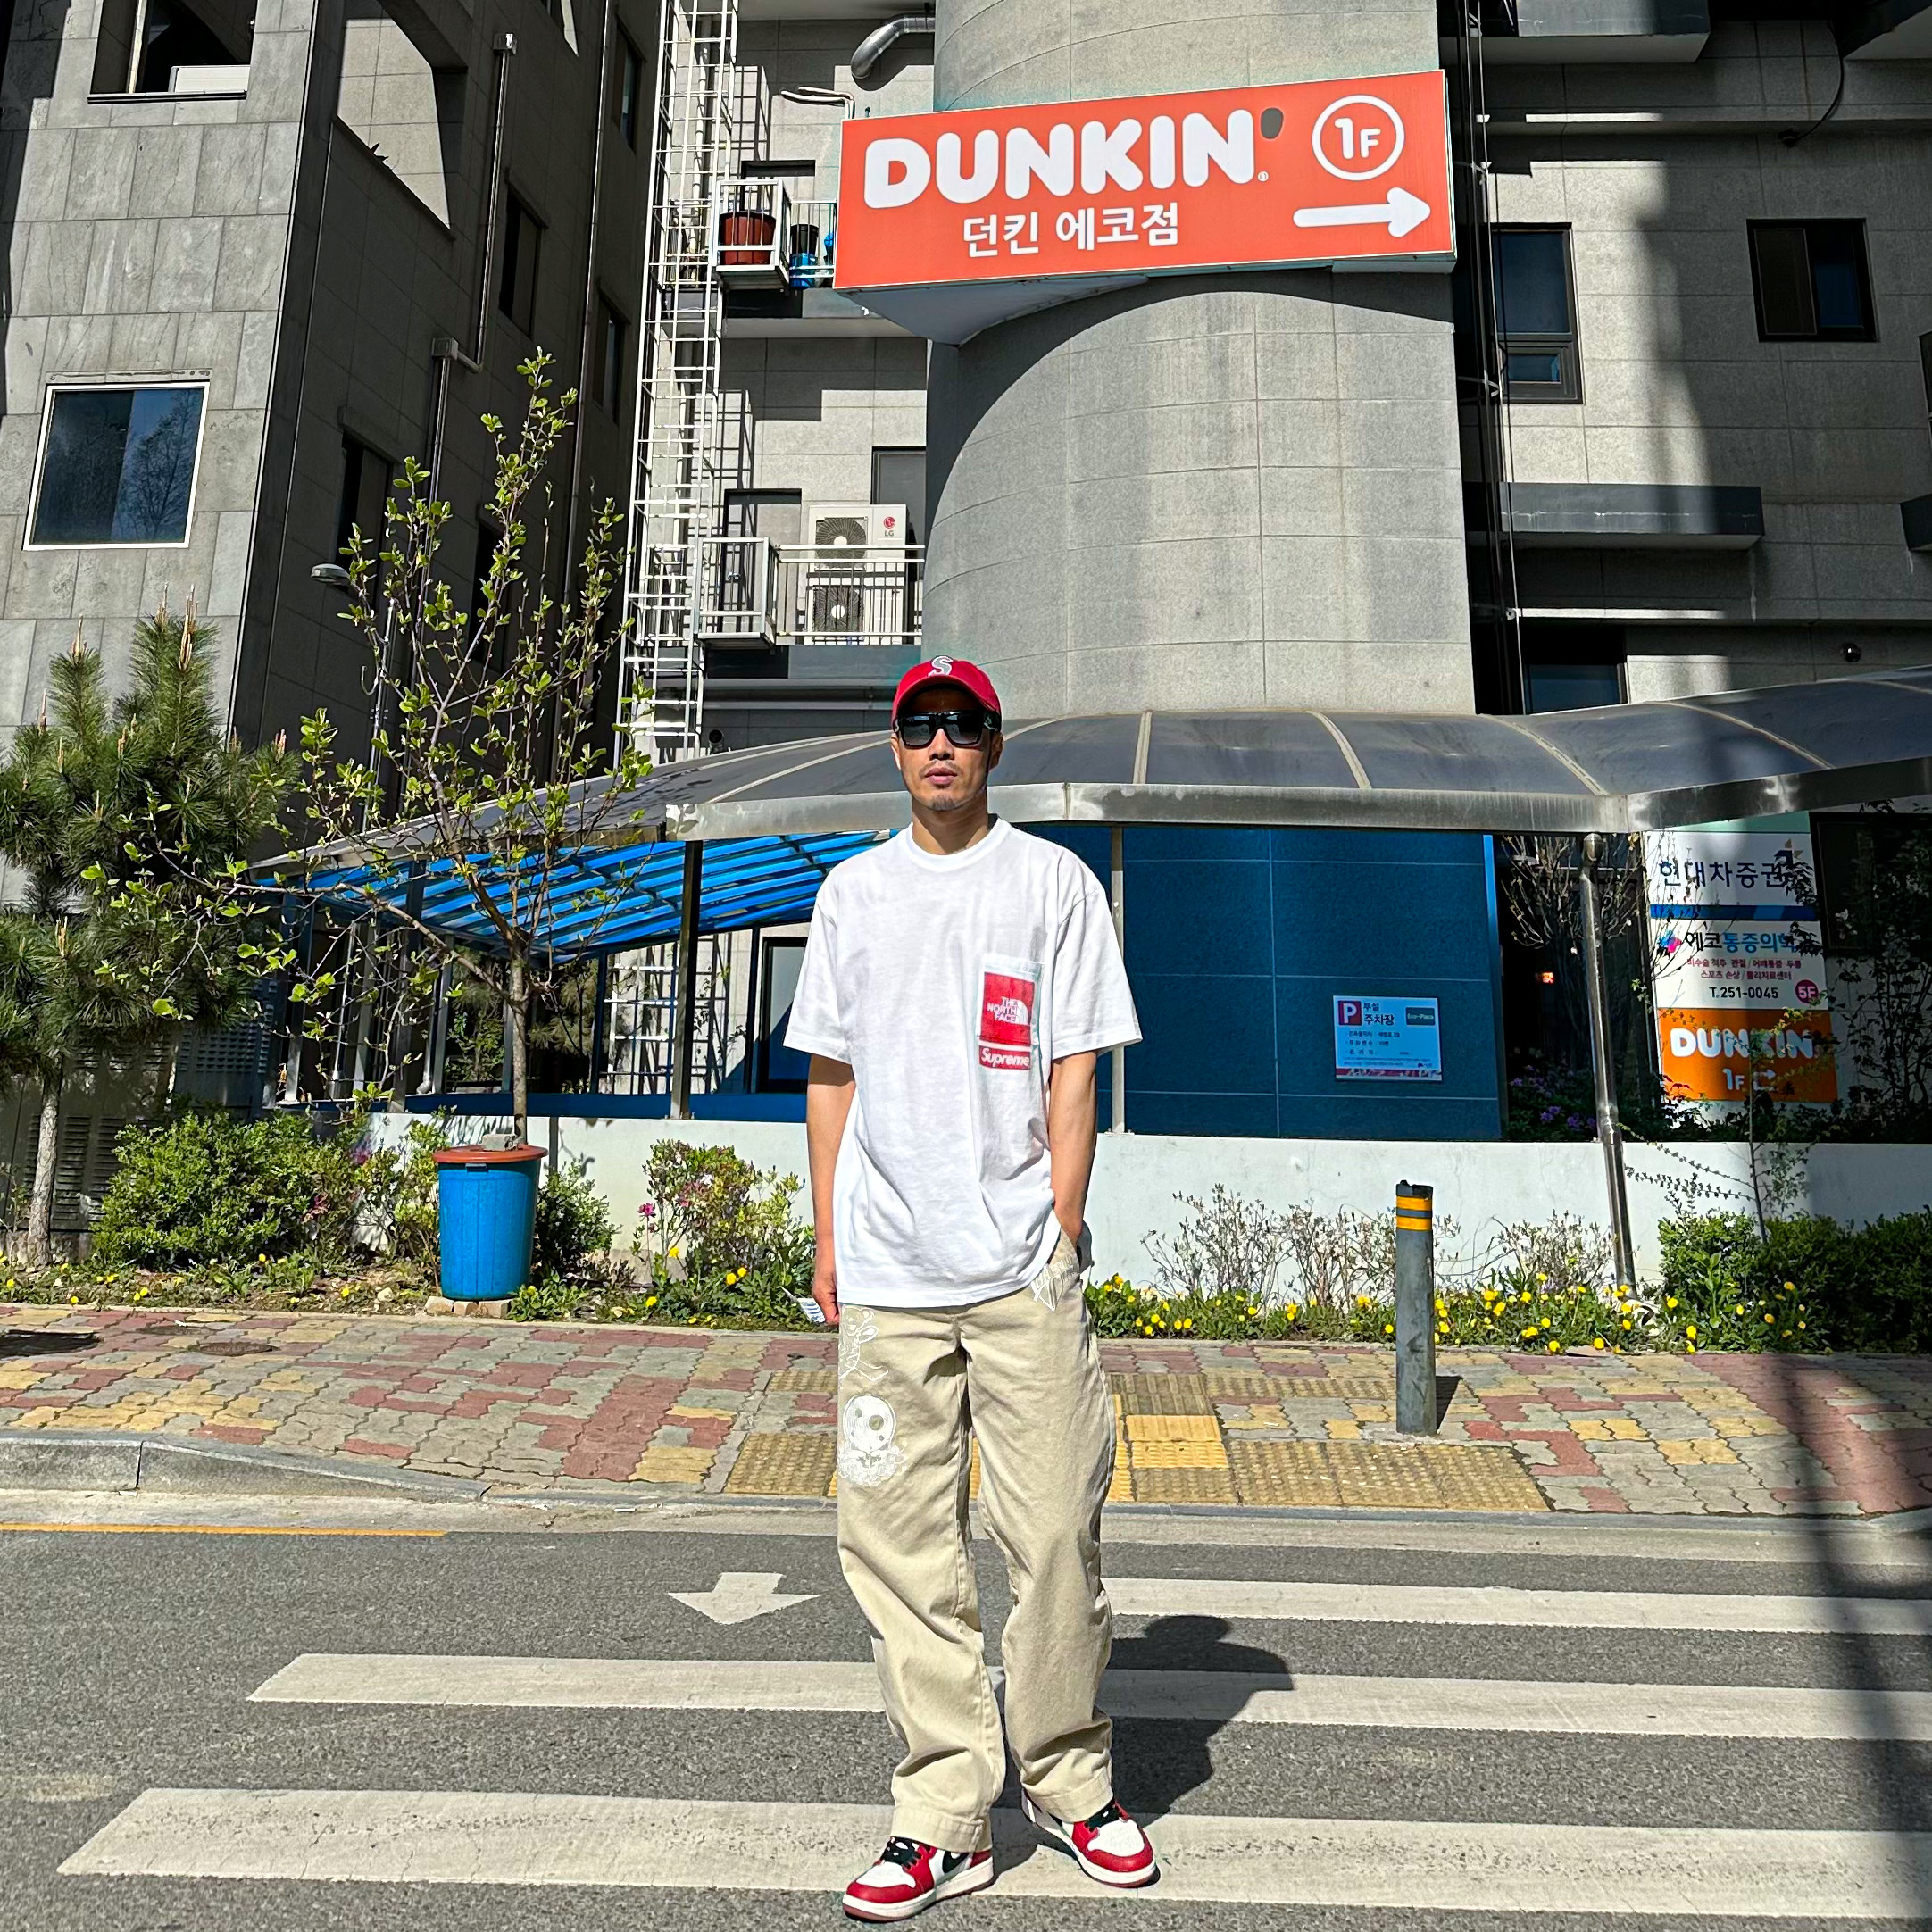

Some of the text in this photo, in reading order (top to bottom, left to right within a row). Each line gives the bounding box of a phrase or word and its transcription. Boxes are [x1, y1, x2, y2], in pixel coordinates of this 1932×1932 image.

[1334, 116, 1382, 162] 1F
[963, 201, 1178, 258] 던킨 에코점
[928, 654, 954, 677] S
[1658, 860, 1787, 889] 현대차증권
[1709, 986, 1779, 999] T.251-0045
[1797, 985, 1816, 1000] 5F
[987, 1002, 1018, 1016] NORTH
[1000, 996, 1019, 1008] THE
[1362, 1002, 1380, 1012] 부설
[994, 1012, 1017, 1023] FACE
[1343, 1003, 1358, 1024] P
[1363, 1014, 1395, 1026] 주차장
[980, 1047, 1030, 1068] Supreme
[1722, 1068, 1745, 1091] 1F
